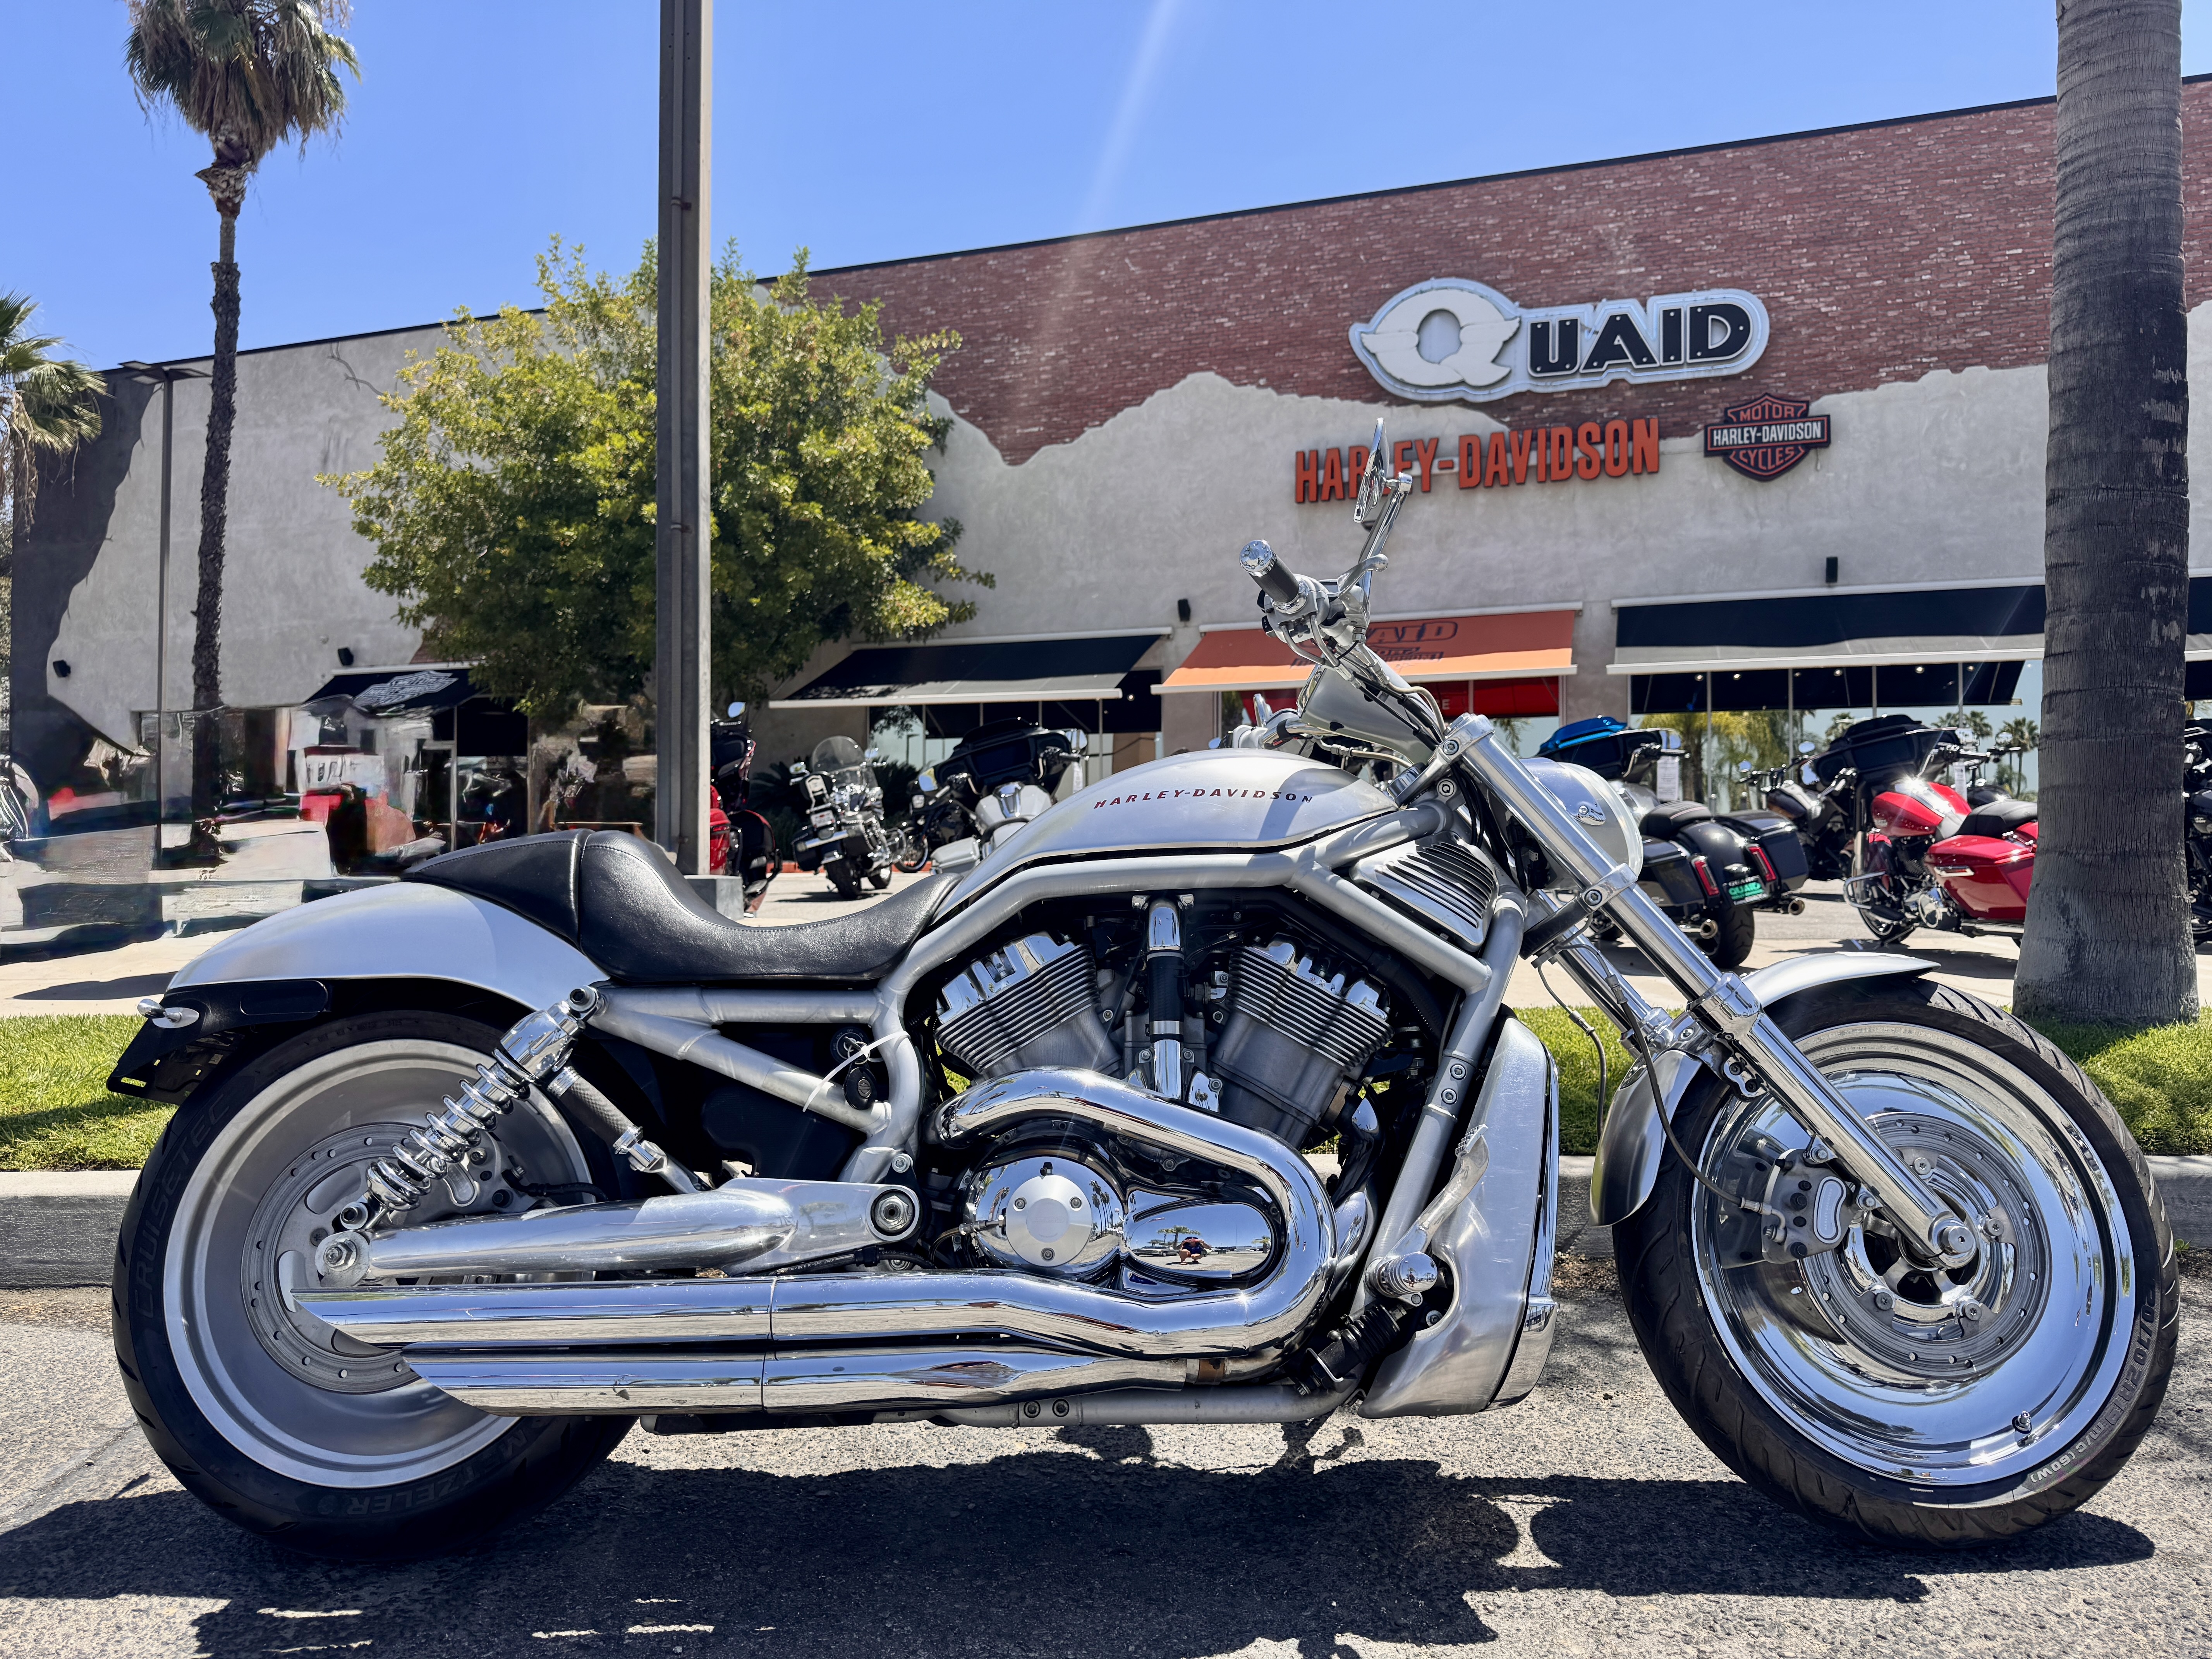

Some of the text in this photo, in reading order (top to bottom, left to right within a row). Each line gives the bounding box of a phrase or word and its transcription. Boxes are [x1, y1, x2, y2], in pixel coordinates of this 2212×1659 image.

[1360, 288, 1753, 386] QUAID
[1740, 401, 1795, 422] MOTOR
[1713, 422, 1821, 446] HARLEY-DAVIDSON
[1295, 418, 1659, 503] HAREY-DAVIDSON
[1739, 447, 1795, 470] CYCLES
[1093, 788, 1313, 809] HARLEY-DAVIDSON
[135, 1093, 230, 1319] CRUISETEC
[2133, 1285, 2156, 1365] 20/70
[2030, 1451, 2076, 1483] (60W)
